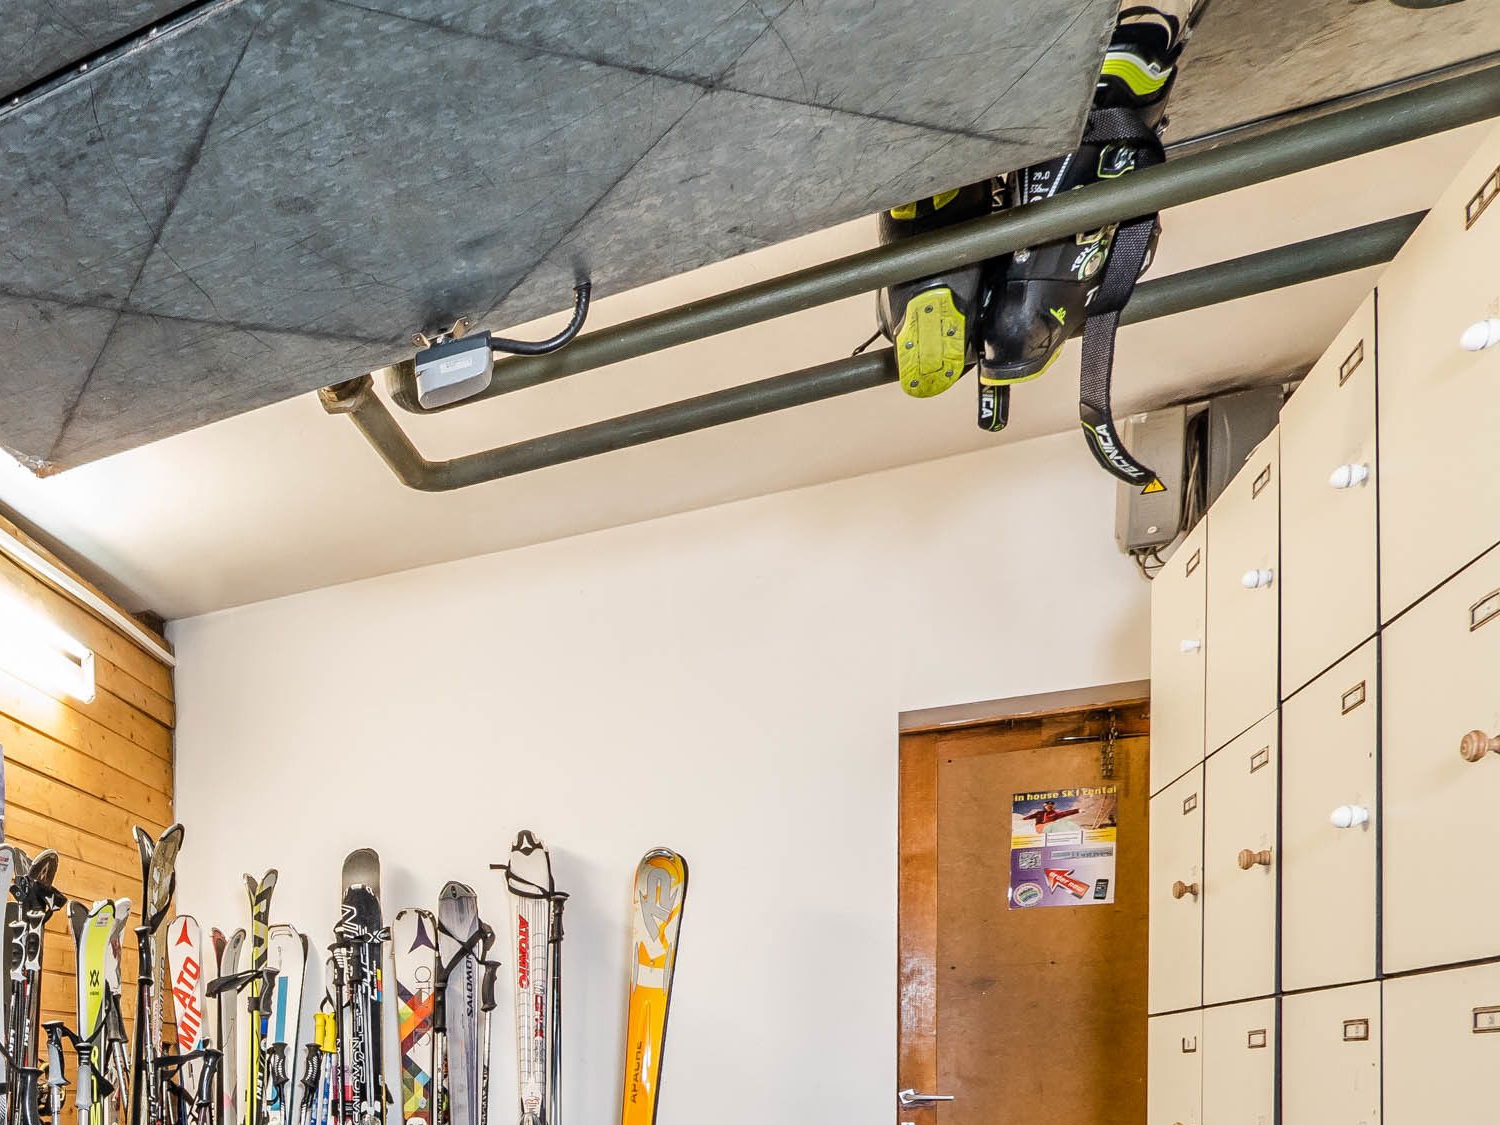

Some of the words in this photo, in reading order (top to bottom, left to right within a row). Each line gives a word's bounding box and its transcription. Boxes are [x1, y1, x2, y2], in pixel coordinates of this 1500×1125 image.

[981, 385, 995, 419] NICA
[1095, 423, 1146, 478] TECNICA
[1027, 792, 1060, 801] house
[1082, 786, 1117, 797] rental
[1048, 871, 1068, 884] order
[517, 914, 530, 990] ATOMIC
[172, 956, 201, 1010] ATO
[23, 1017, 31, 1047] LEKI
